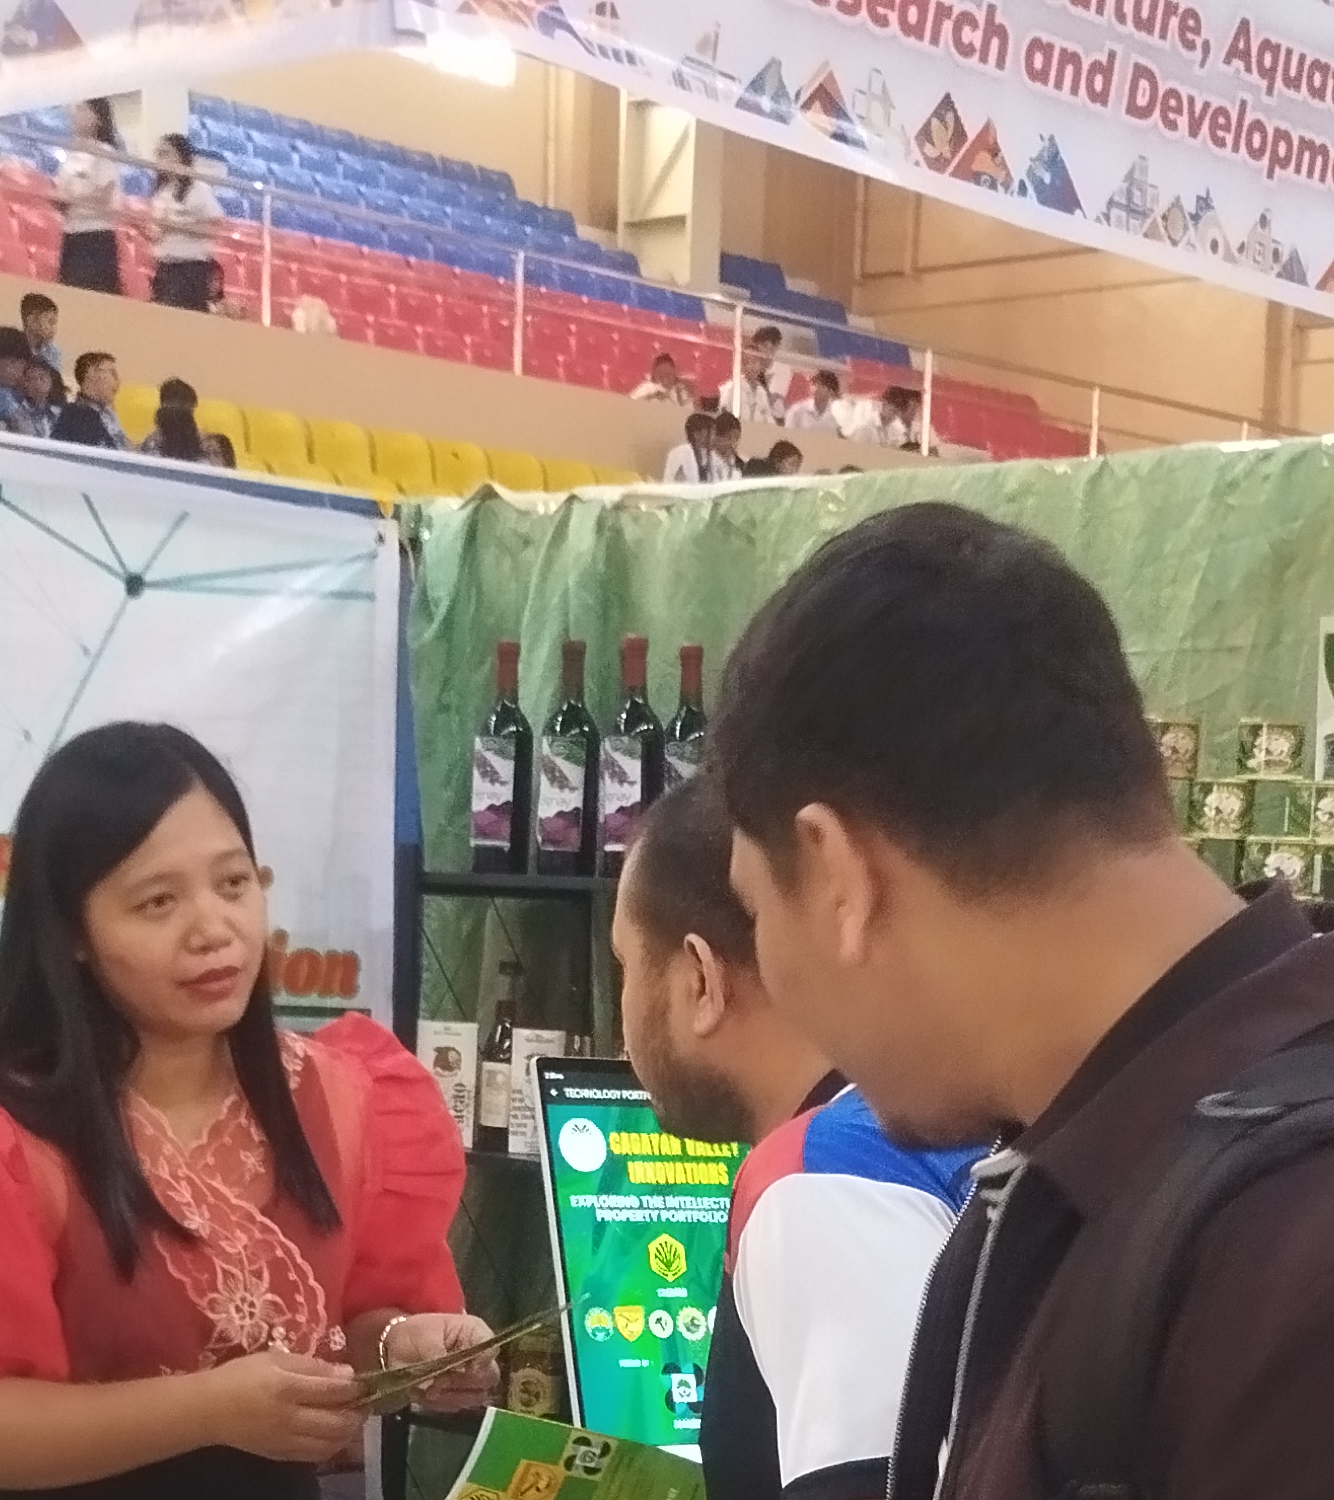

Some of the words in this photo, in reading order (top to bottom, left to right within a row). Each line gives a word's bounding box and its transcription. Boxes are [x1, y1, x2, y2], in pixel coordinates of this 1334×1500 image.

[810, 0, 1010, 71] earch
[1022, 35, 1117, 108] and
[608, 1132, 682, 1155] CAGAYAN
[626, 1161, 729, 1185] INNOVATIONS
